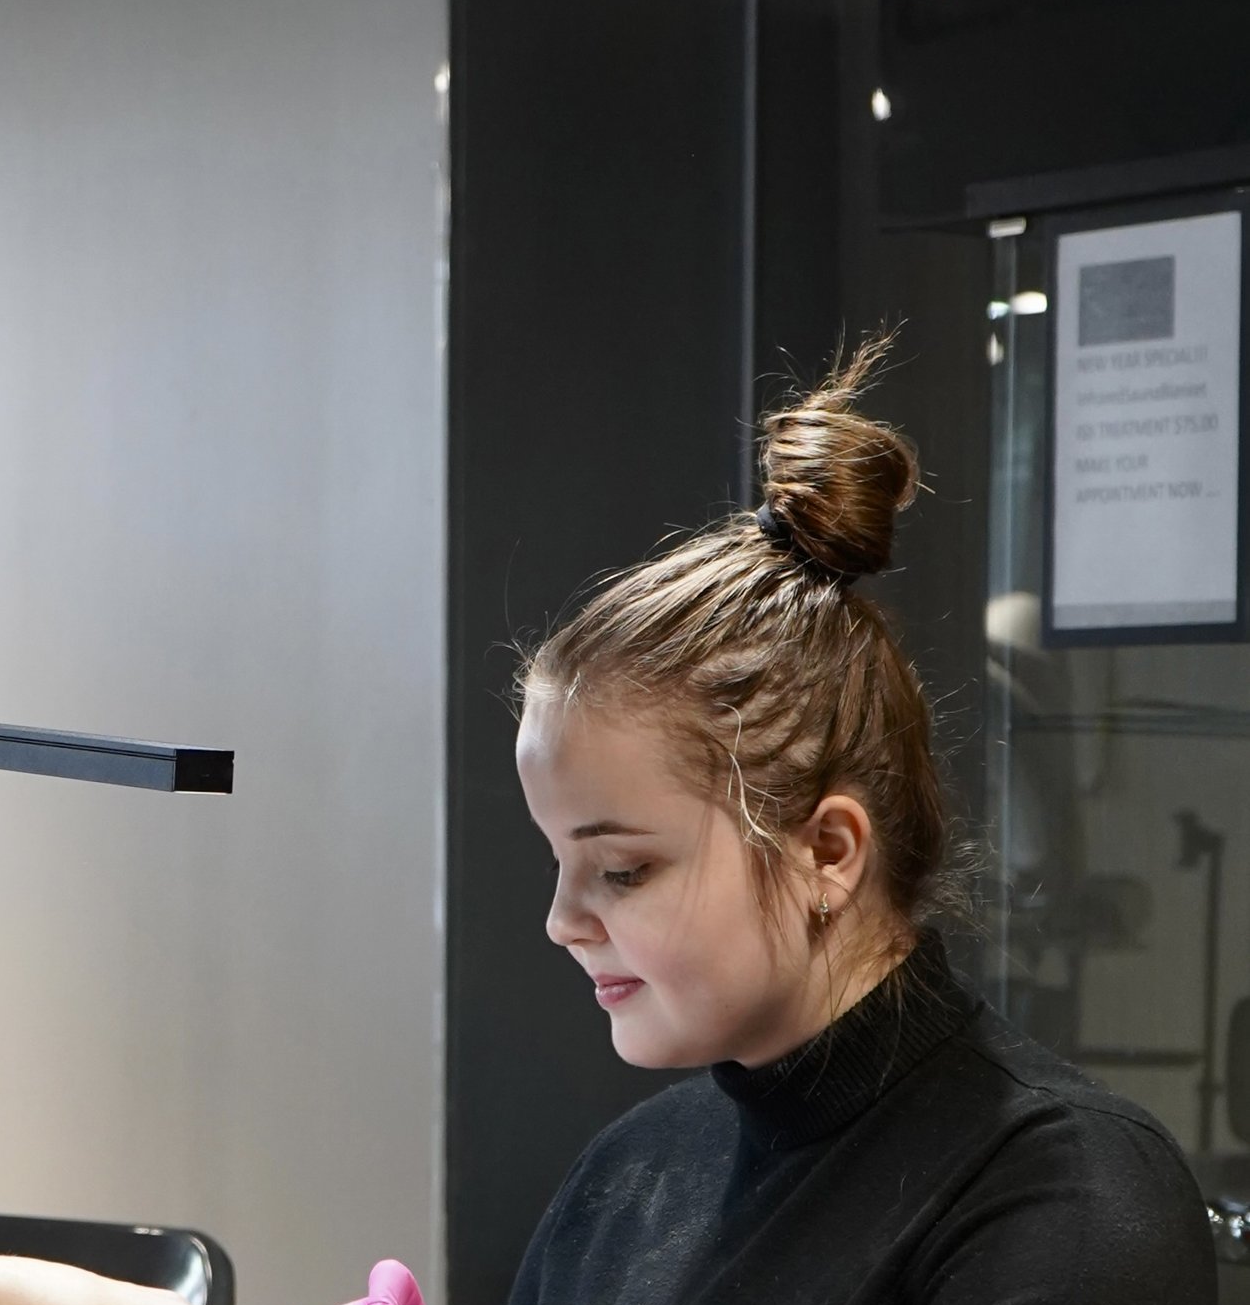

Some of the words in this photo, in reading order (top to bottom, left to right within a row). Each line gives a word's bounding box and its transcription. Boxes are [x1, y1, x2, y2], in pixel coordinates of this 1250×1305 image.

[1110, 351, 1141, 370] YEAR
[1115, 454, 1149, 472] YOUR
[1075, 483, 1164, 504] APPOINTMENT
[1167, 480, 1204, 499] NOW
